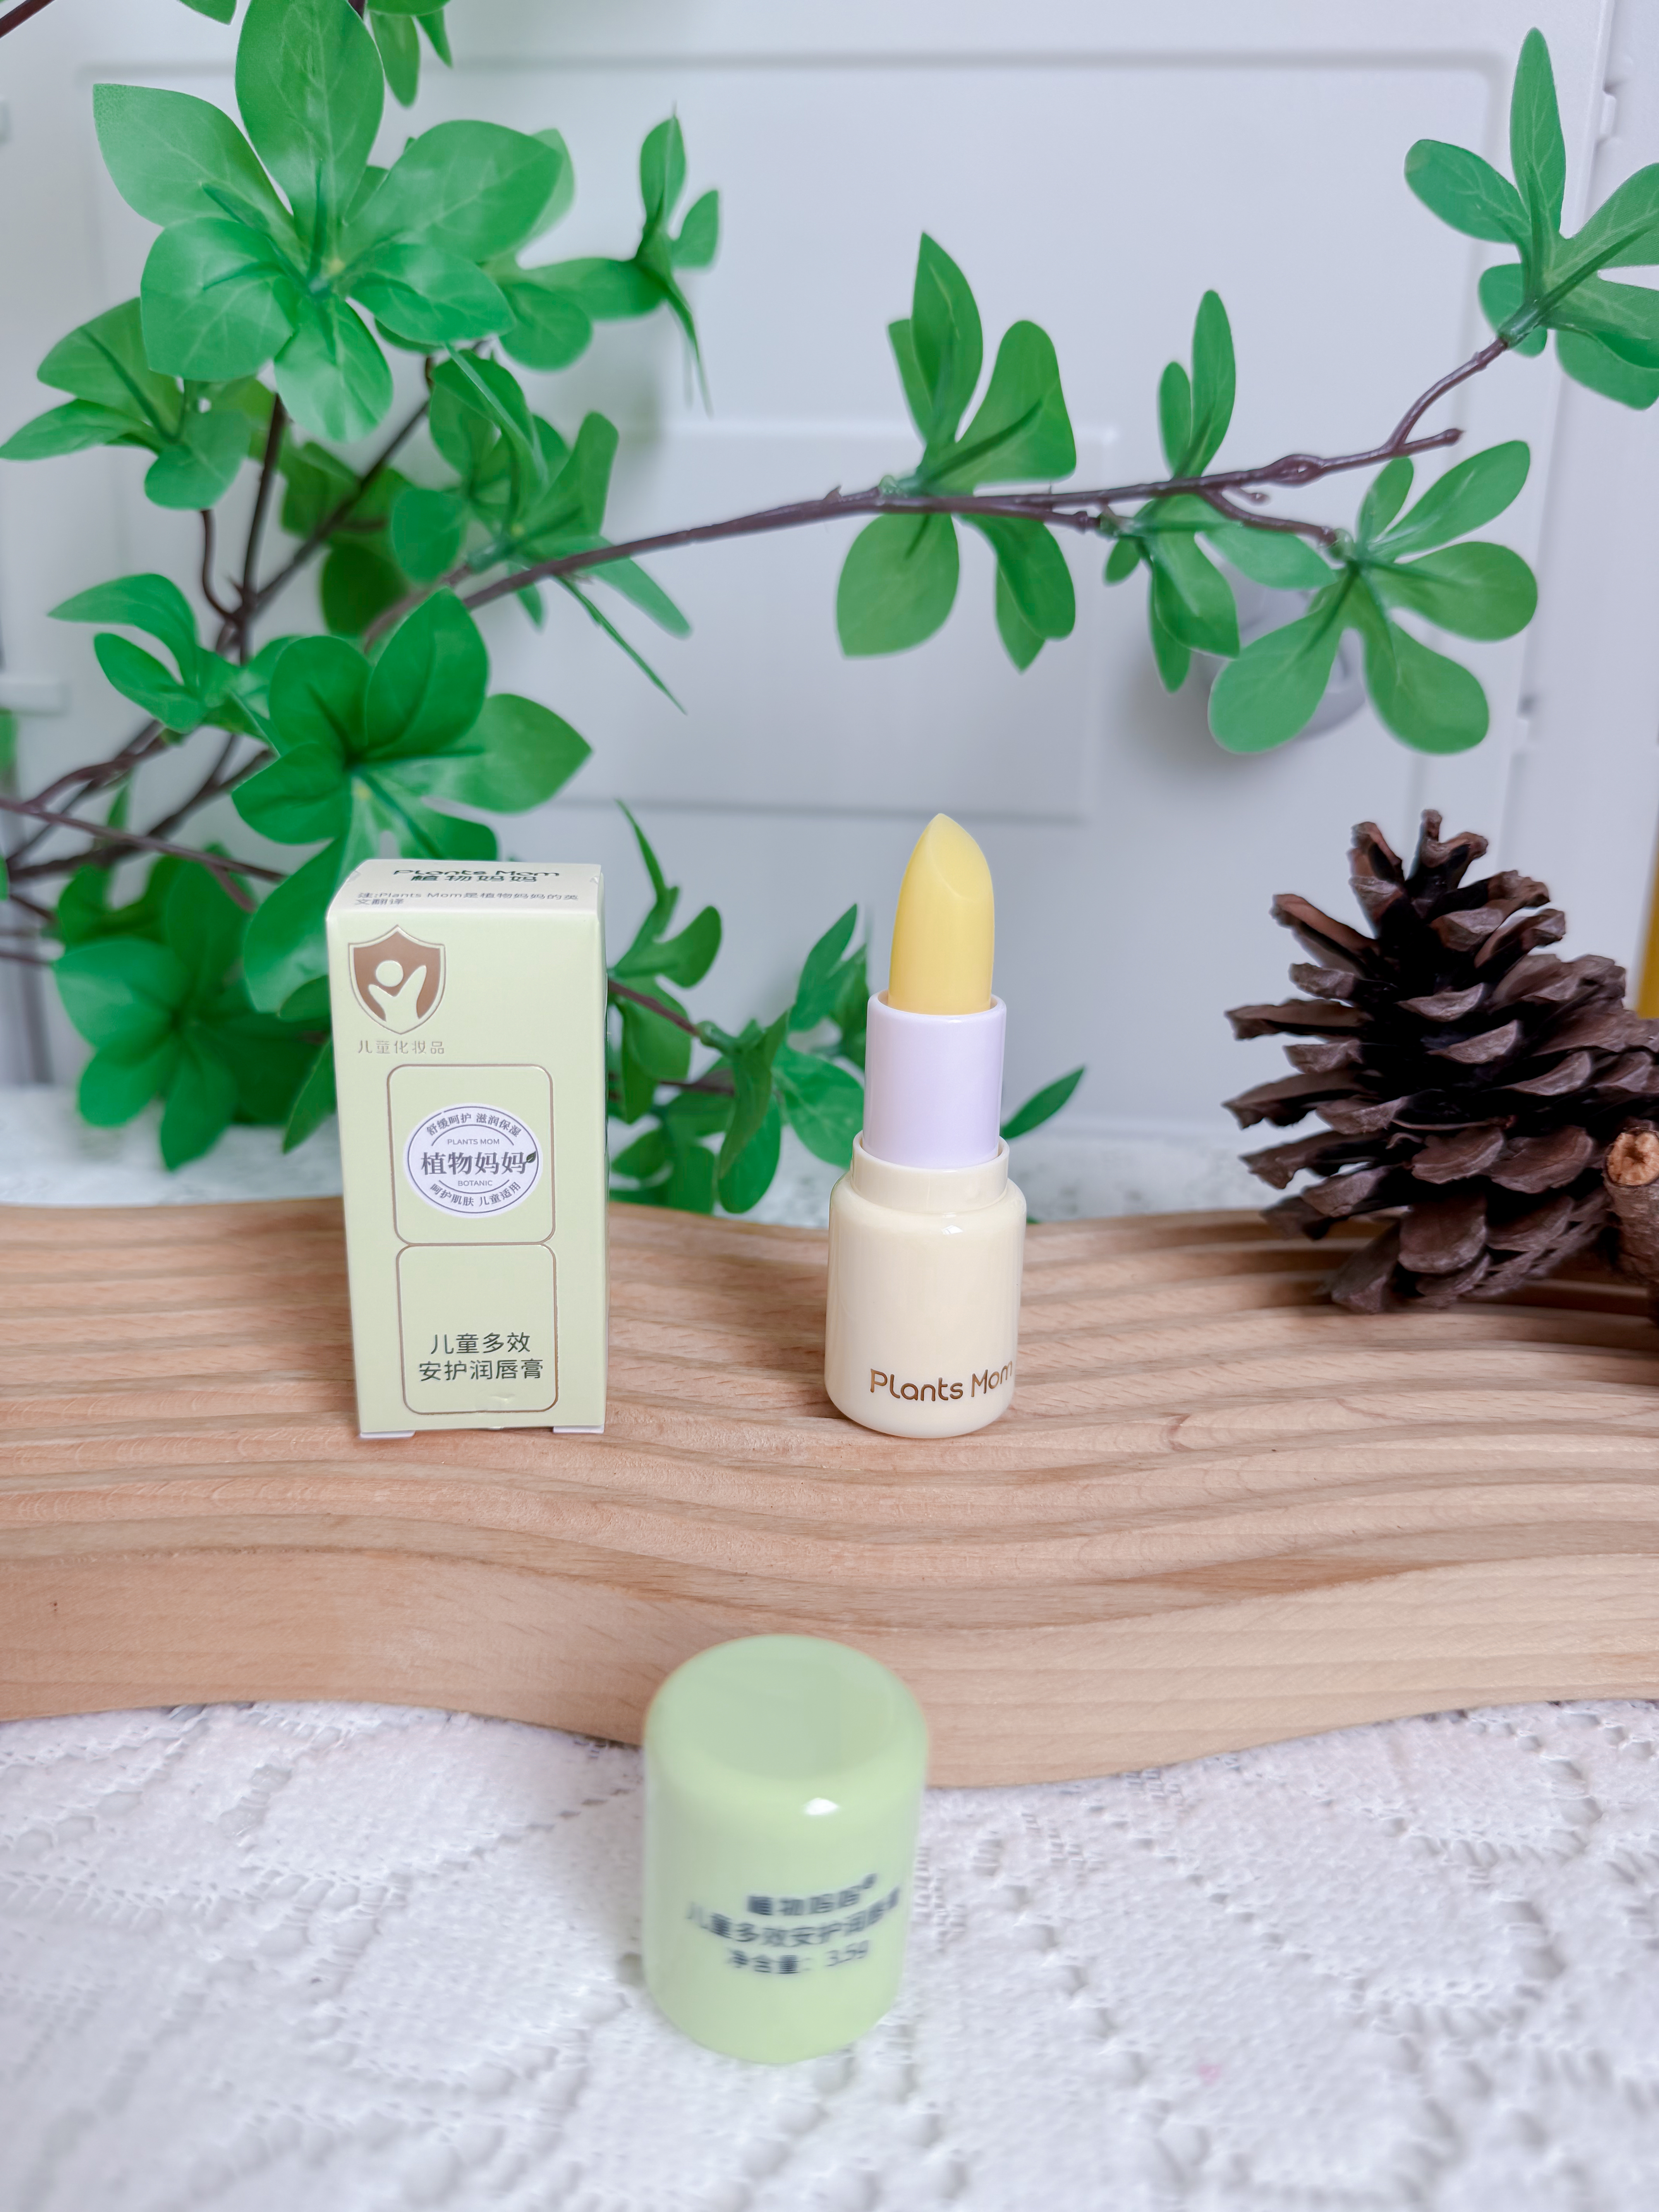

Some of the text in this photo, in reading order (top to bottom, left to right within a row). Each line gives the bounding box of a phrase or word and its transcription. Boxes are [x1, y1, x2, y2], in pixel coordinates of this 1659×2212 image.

[358, 1041, 445, 1054] 儿童化妆品
[426, 1113, 522, 1137] 舒缓呵护 滋润保湿
[421, 1151, 527, 1175] 植物妈妈
[430, 1182, 521, 1207] 呵护肌肤 儿童适用
[431, 1331, 531, 1355] 儿童多效
[419, 1358, 543, 1381] 安护润唇膏
[870, 1360, 1013, 1402] Plants Mom
